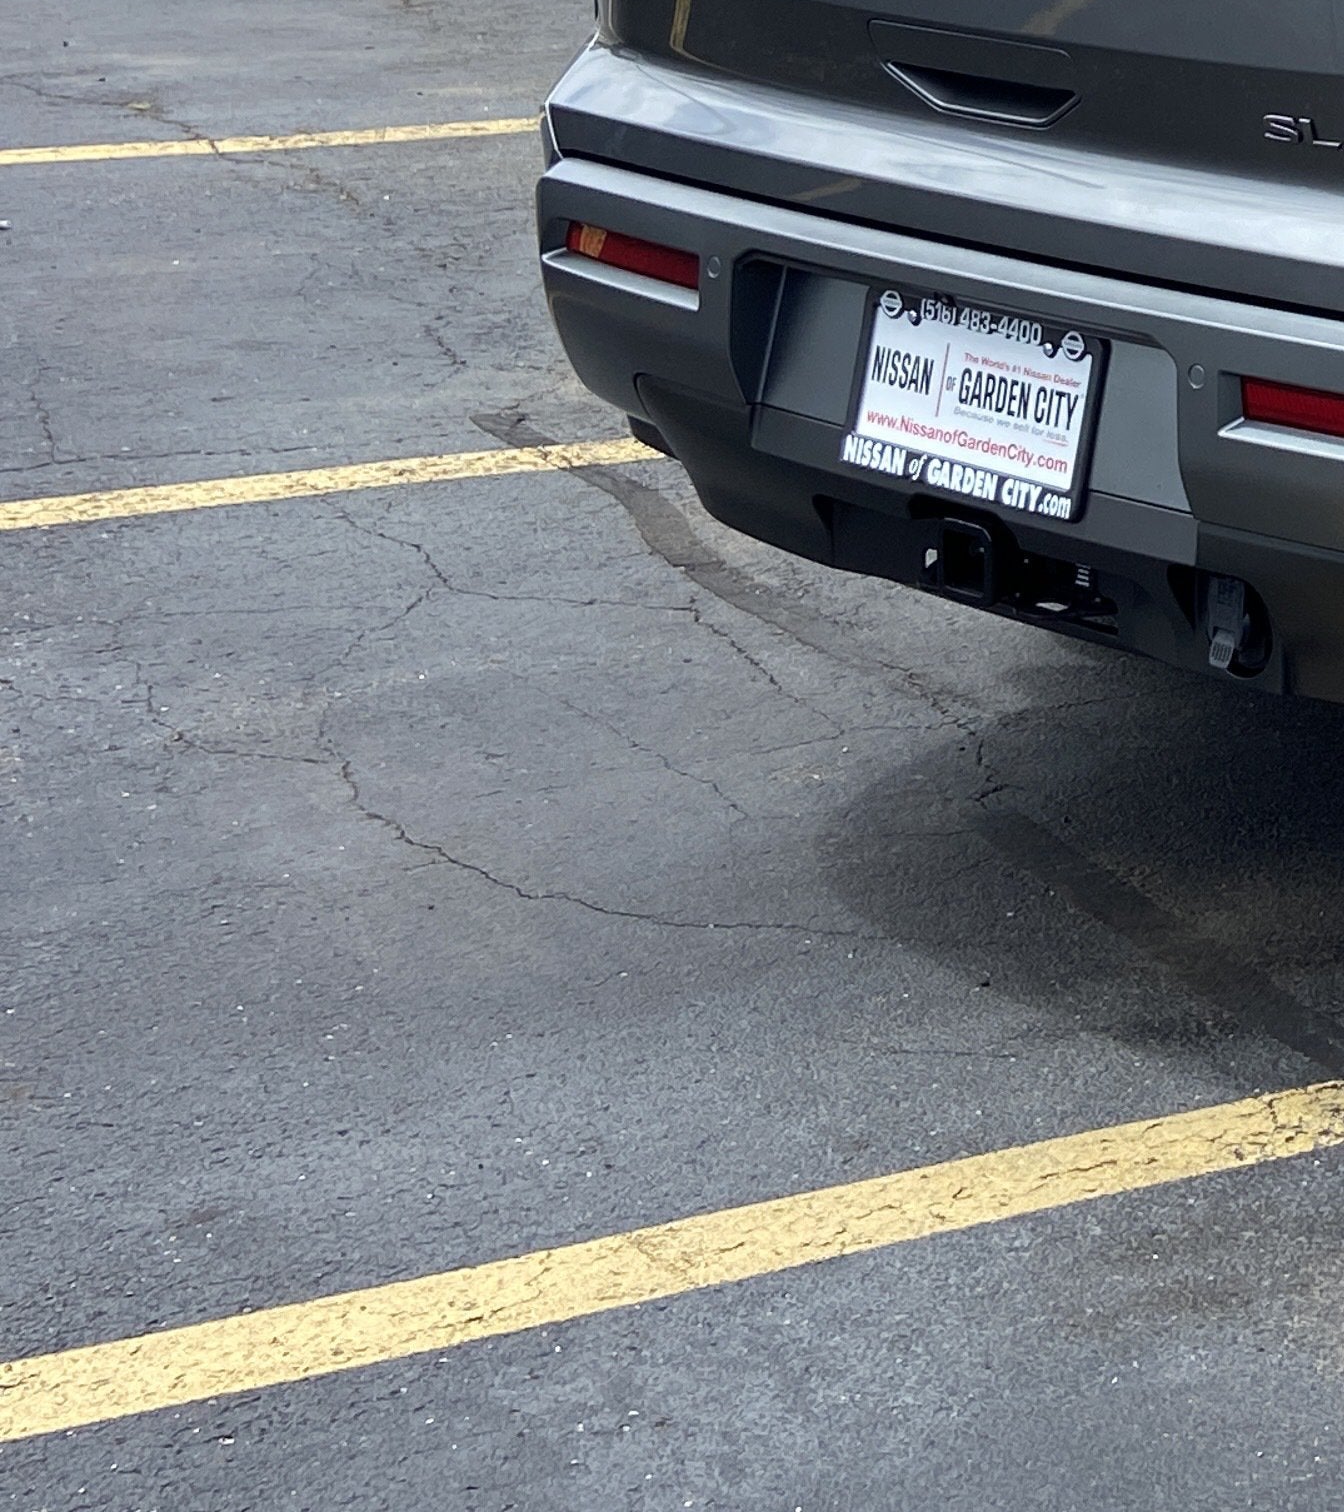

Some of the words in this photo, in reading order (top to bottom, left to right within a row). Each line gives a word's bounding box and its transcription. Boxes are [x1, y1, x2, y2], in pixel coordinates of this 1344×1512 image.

[1262, 113, 1343, 150] SL
[960, 307, 1043, 345] 483-4400
[964, 352, 979, 365] The
[870, 345, 934, 396] NISSAN
[946, 375, 957, 392] OF
[958, 367, 1032, 420] GARDEN
[1034, 386, 1079, 431] CITY
[866, 409, 1068, 474] www.NissanofGardenCity.com
[843, 434, 907, 477] NISSAN
[908, 453, 928, 481] of
[927, 458, 999, 501] GARDEN
[1001, 478, 1072, 520] CITY.com
